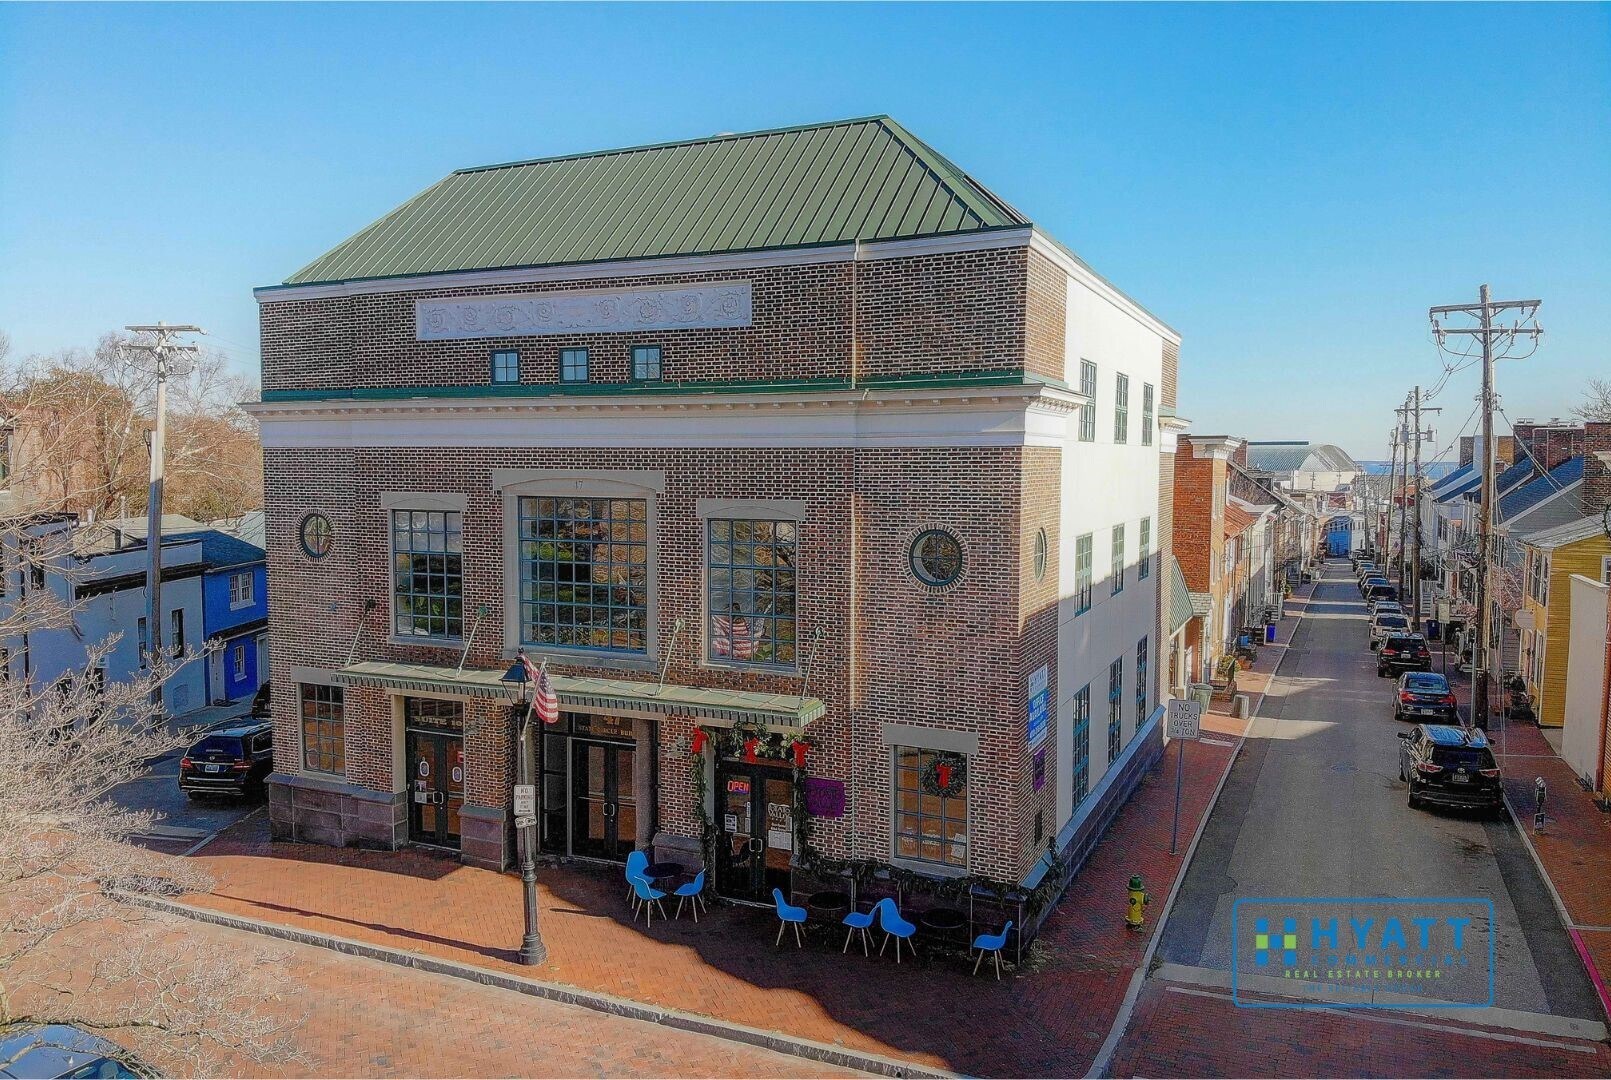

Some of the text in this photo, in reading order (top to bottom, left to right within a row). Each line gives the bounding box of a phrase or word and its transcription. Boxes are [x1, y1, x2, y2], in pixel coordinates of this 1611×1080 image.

[1178, 703, 1191, 712] NO
[414, 716, 448, 725] SUITE
[1170, 712, 1198, 720] TRUCKS
[1173, 720, 1193, 728] OVER
[727, 780, 749, 792] OPEN
